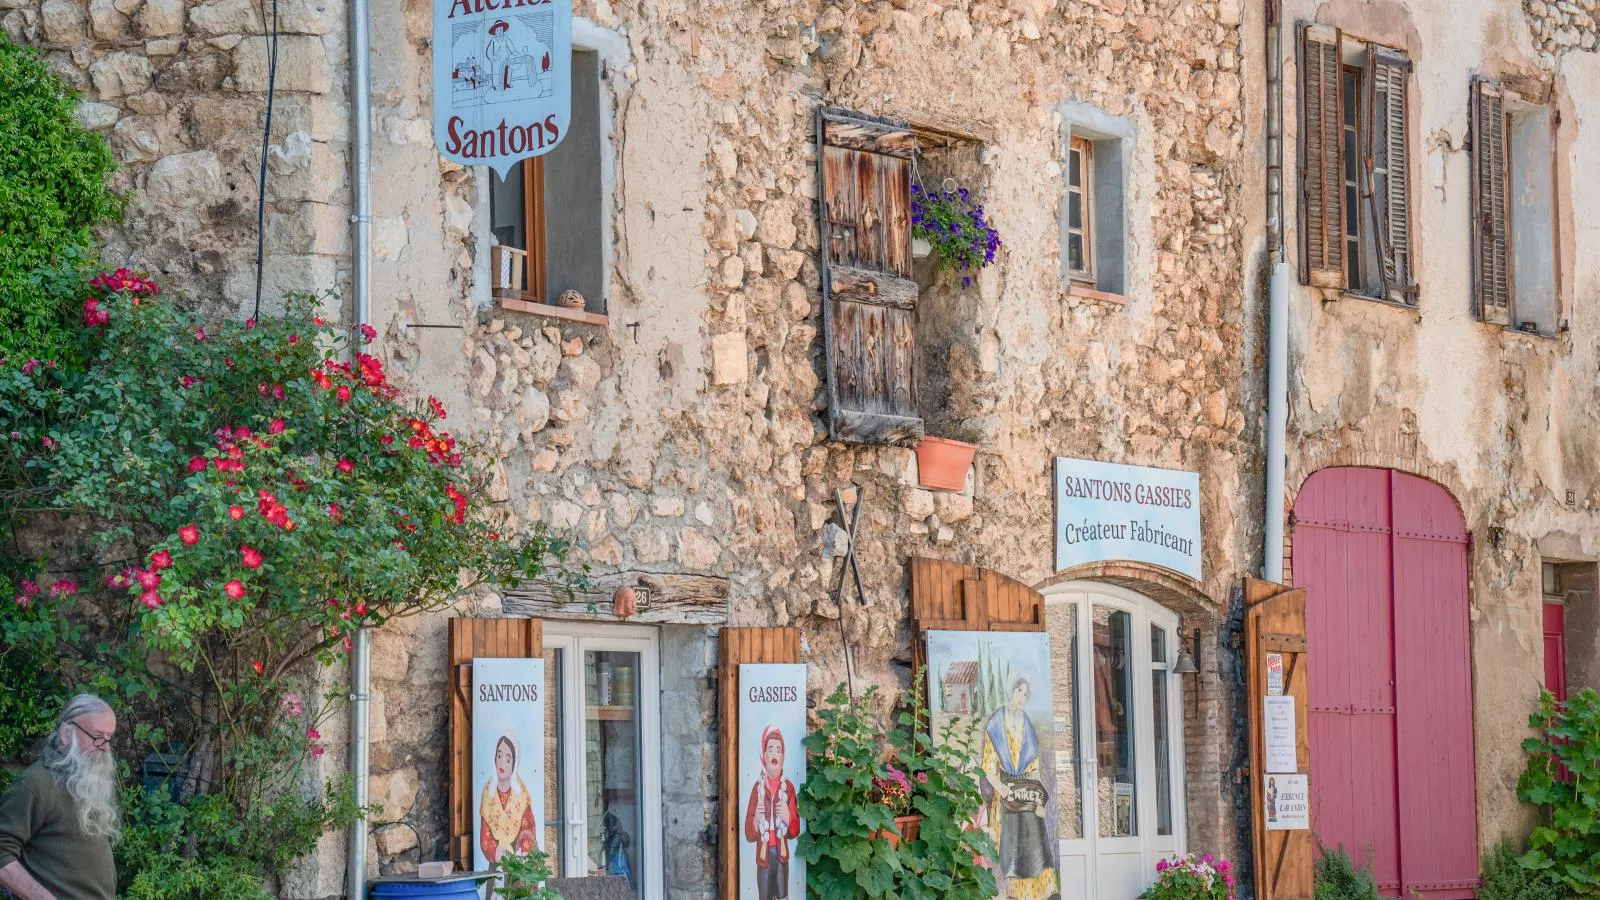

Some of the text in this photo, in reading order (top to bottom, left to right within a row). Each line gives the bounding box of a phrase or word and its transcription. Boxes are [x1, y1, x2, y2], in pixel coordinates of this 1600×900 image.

[445, 113, 559, 158] Santons
[1065, 476, 1192, 509] SANTONS GASSIES
[1065, 518, 1193, 557] Créateur Fabricant
[480, 684, 537, 701] SANTONS
[749, 686, 797, 702] GASSIES
